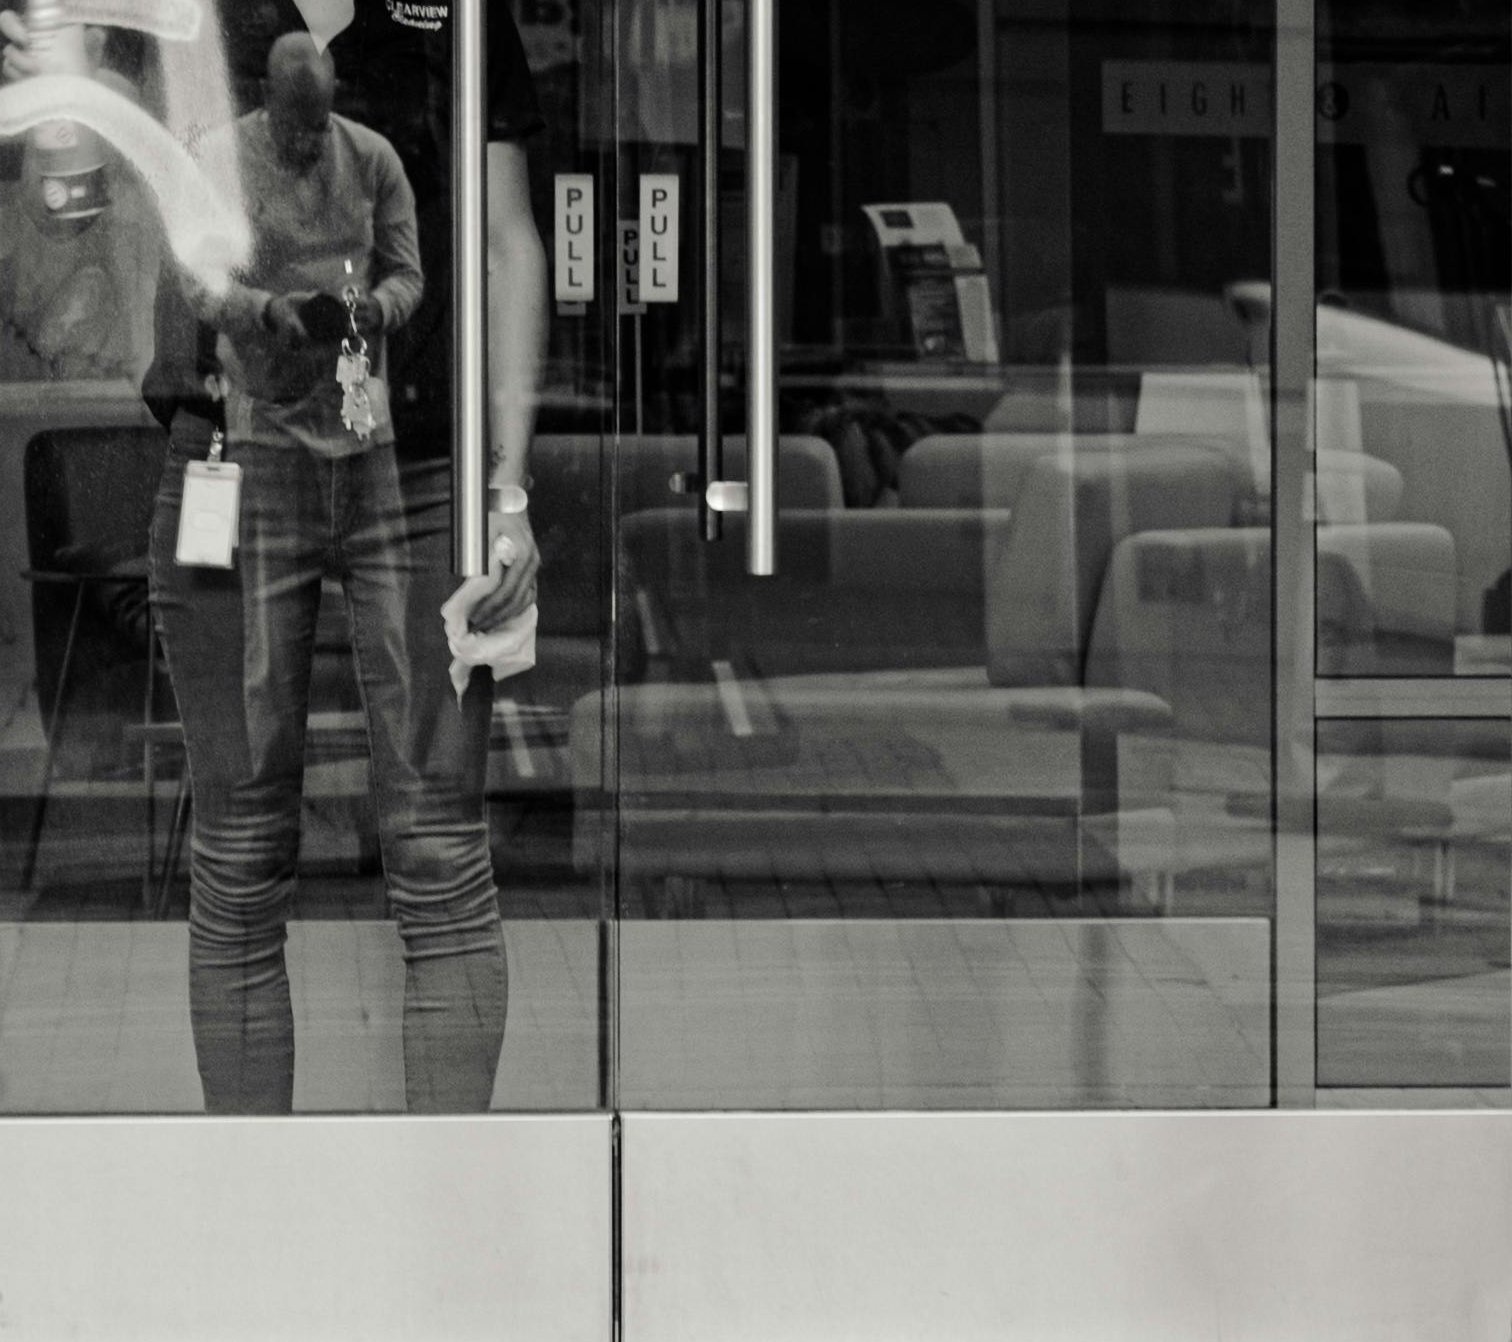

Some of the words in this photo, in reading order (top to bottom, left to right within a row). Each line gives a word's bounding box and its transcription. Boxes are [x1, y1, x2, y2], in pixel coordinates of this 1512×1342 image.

[1120, 81, 1246, 116] EIGH
[565, 187, 583, 288] PULL
[623, 230, 639, 305] PULL
[650, 188, 668, 289] PULL
